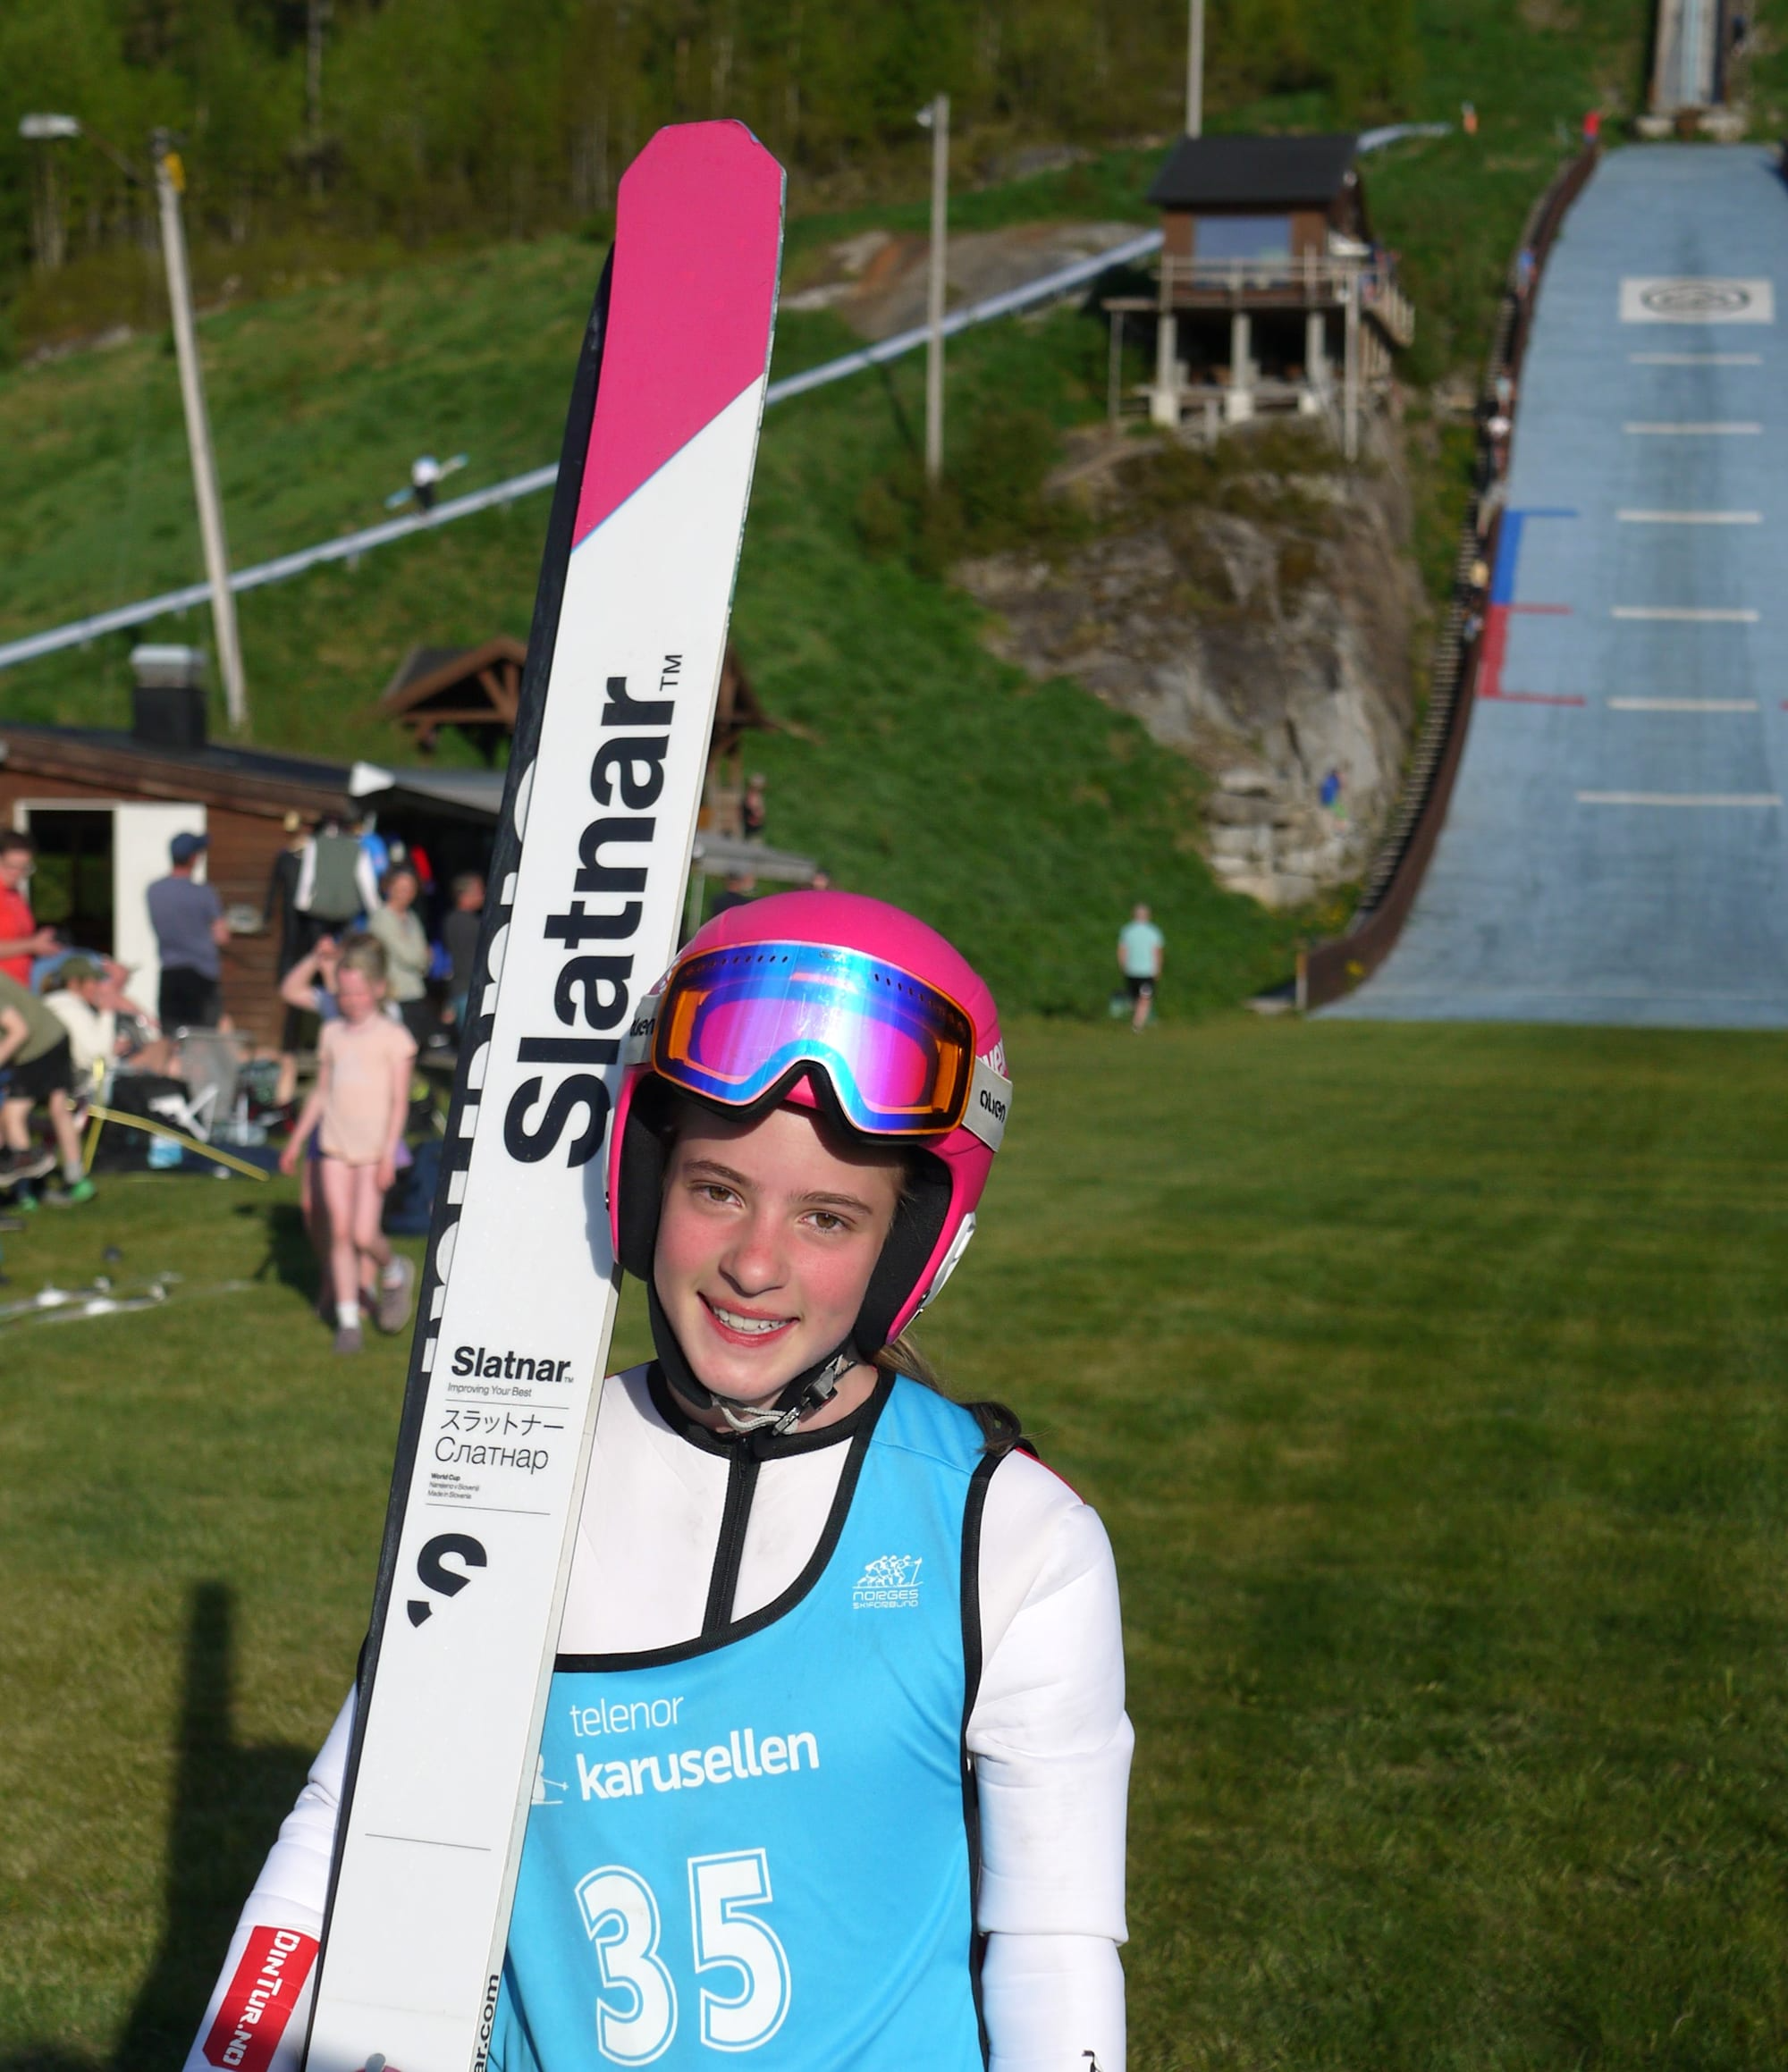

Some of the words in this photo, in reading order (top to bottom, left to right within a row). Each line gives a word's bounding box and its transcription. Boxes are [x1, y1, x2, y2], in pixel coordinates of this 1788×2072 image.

[503, 677, 675, 1167] Slatnar
[451, 1345, 571, 1383] Slatnar
[448, 1383, 489, 1396] Improving
[491, 1386, 510, 1396] Your
[511, 1386, 533, 1397] Best
[441, 1409, 564, 1436] スラットナー
[434, 1436, 549, 1475] Слатнар
[852, 1588, 919, 1601] NORGES
[852, 1599, 919, 1610] SKIFORBUND
[569, 1695, 685, 1737] telenor
[576, 1728, 820, 1801] karusellen
[575, 1848, 792, 2067] 35
